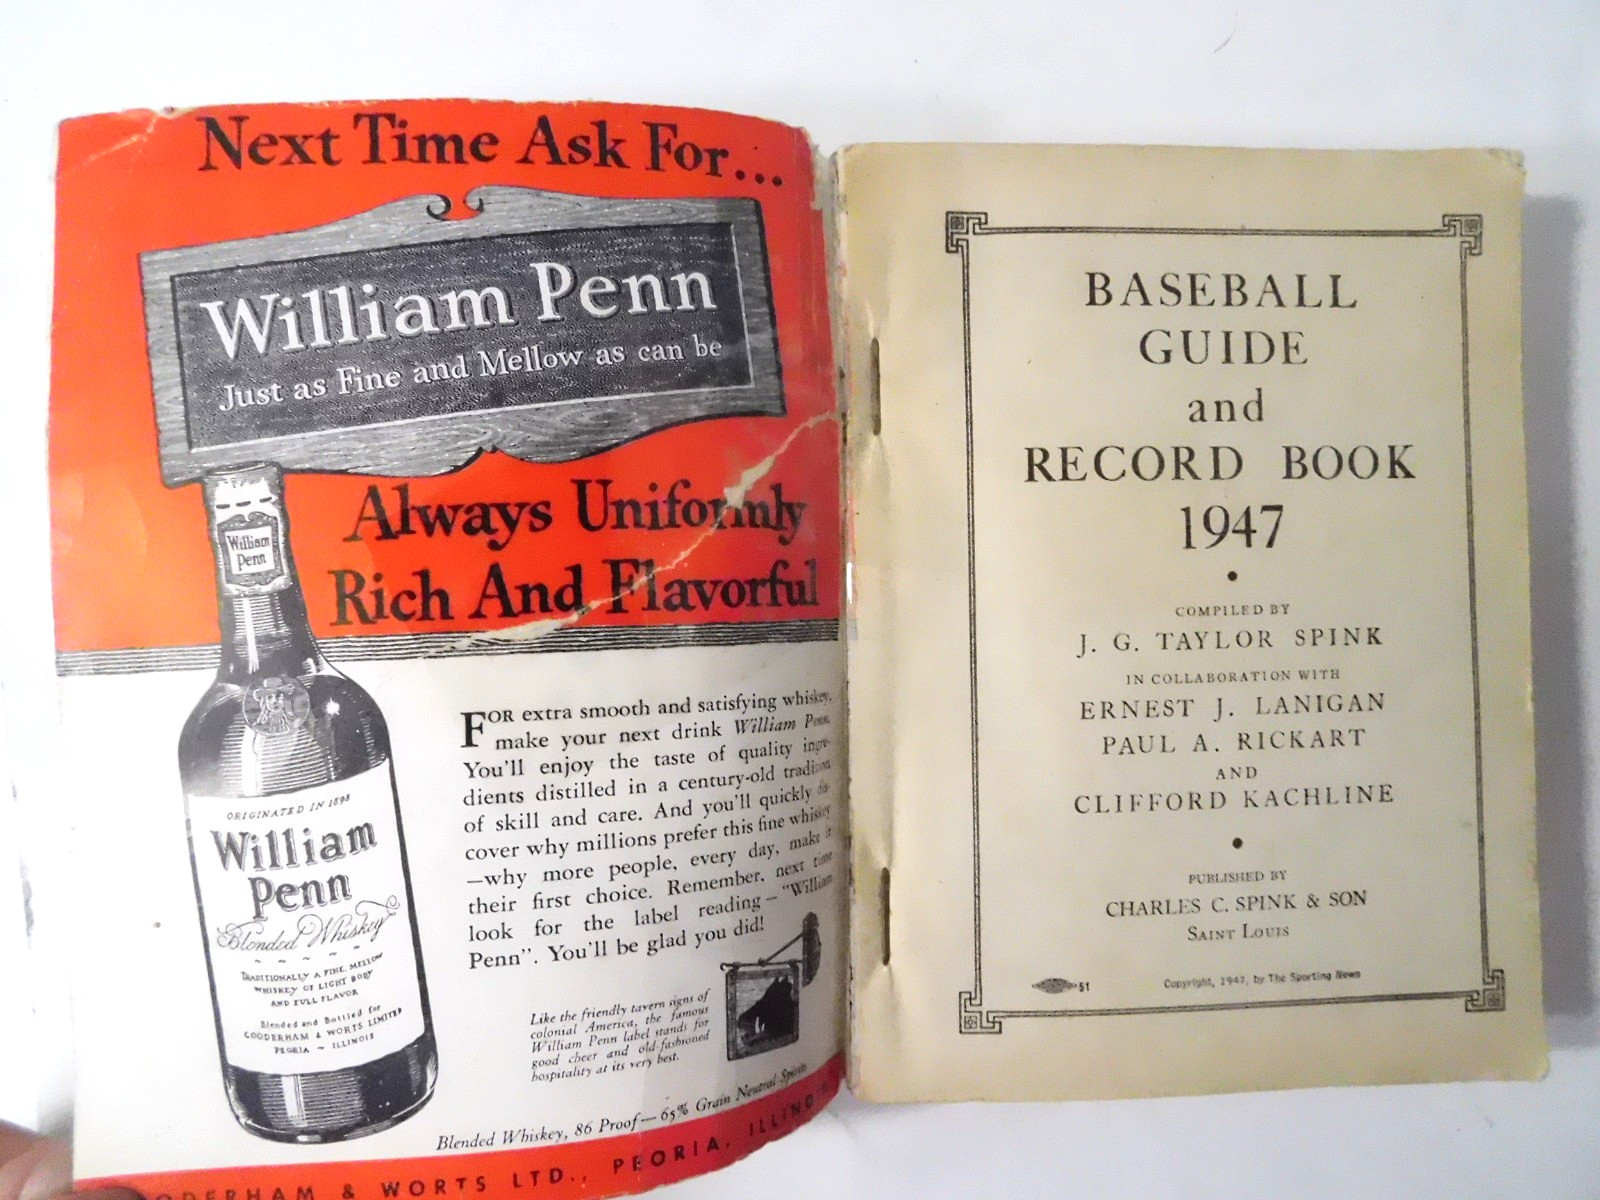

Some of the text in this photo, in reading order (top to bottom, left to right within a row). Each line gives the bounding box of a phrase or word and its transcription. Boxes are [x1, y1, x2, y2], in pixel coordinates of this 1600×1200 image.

[197, 115, 341, 171] Next
[353, 112, 500, 164] Time
[516, 115, 631, 169] Ask
[1085, 272, 1357, 308] BASEBALL
[201, 261, 717, 362] William Penn
[1139, 329, 1308, 365] GUIDE
[217, 335, 722, 413] Just as Fine and Mellow as can be
[1188, 387, 1264, 423] and
[1024, 444, 1416, 483] RECORD BOOK
[343, 482, 553, 552] Always
[1180, 504, 1284, 549] 1947
[226, 535, 270, 551] William
[236, 553, 267, 572] Penn
[328, 559, 819, 626] Rich And Flavorful
[1175, 603, 1290, 617] COMPILED BY
[1076, 627, 1383, 659] J. G. TAYLOR SPINK
[1126, 669, 1340, 685] IN COLLABORATION WITH
[522, 708, 572, 722] extra
[580, 699, 650, 719] smooth
[658, 696, 691, 714] and
[698, 693, 777, 715] satisfying
[1080, 693, 1384, 722] ERNEST J. LANIGAN
[496, 716, 796, 752] make your next drink William
[1102, 728, 1366, 756] PAUL A. RICKART
[463, 740, 792, 779] You'll enjoy the taste of quality
[1216, 766, 1257, 780] AND
[463, 766, 774, 806] dients distilled in a century-old
[1074, 784, 1394, 814] CLIFFORD KACHLINE
[227, 805, 304, 820] ORIGINATED
[464, 814, 485, 833] of
[496, 811, 539, 832] skill
[551, 808, 587, 827] and
[598, 810, 642, 824] care.
[654, 799, 692, 819] And
[702, 792, 751, 819] you'll
[759, 784, 812, 811] quickly
[210, 822, 378, 872] William
[465, 815, 785, 860] cover why millions prefer this fine
[543, 866, 594, 882] more
[609, 854, 677, 882] people,
[690, 850, 736, 867] every
[748, 841, 779, 860] day,
[1188, 870, 1287, 885] PUBLISHED BY
[248, 874, 352, 921] Penn
[468, 861, 804, 915] their first choice. Remember, next
[1106, 890, 1366, 918] CHARLES C. SPINK & SON
[216, 894, 401, 951] Blended Whiskey
[469, 922, 514, 942] look
[535, 918, 562, 936] for
[584, 914, 614, 932] the
[634, 904, 678, 926] label
[547, 940, 607, 961] You'll
[616, 938, 638, 955] be
[646, 929, 686, 956] glad
[695, 928, 727, 949] you
[733, 915, 764, 936] did!
[254, 986, 298, 997] WHISKEY
[1253, 974, 1265, 985] by
[1268, 973, 1286, 983] The
[1290, 971, 1332, 983] Sporting
[1335, 970, 1361, 980] News
[326, 1022, 363, 1036] WORTS
[530, 1001, 665, 1026] Like the friendly tavern
[530, 1023, 577, 1040] colonial
[531, 1044, 630, 1070] good cheer and
[532, 1027, 650, 1053] William Penn label
[531, 1065, 591, 1083] hospitality
[436, 1131, 496, 1151] Blended
[503, 1126, 568, 1145] Whiskey,
[574, 1123, 592, 1136] 86
[695, 1096, 730, 1112] Grain
[736, 1071, 776, 1099] Neutral
[342, 1184, 354, 1198] &
[381, 1175, 486, 1198] WORTS
